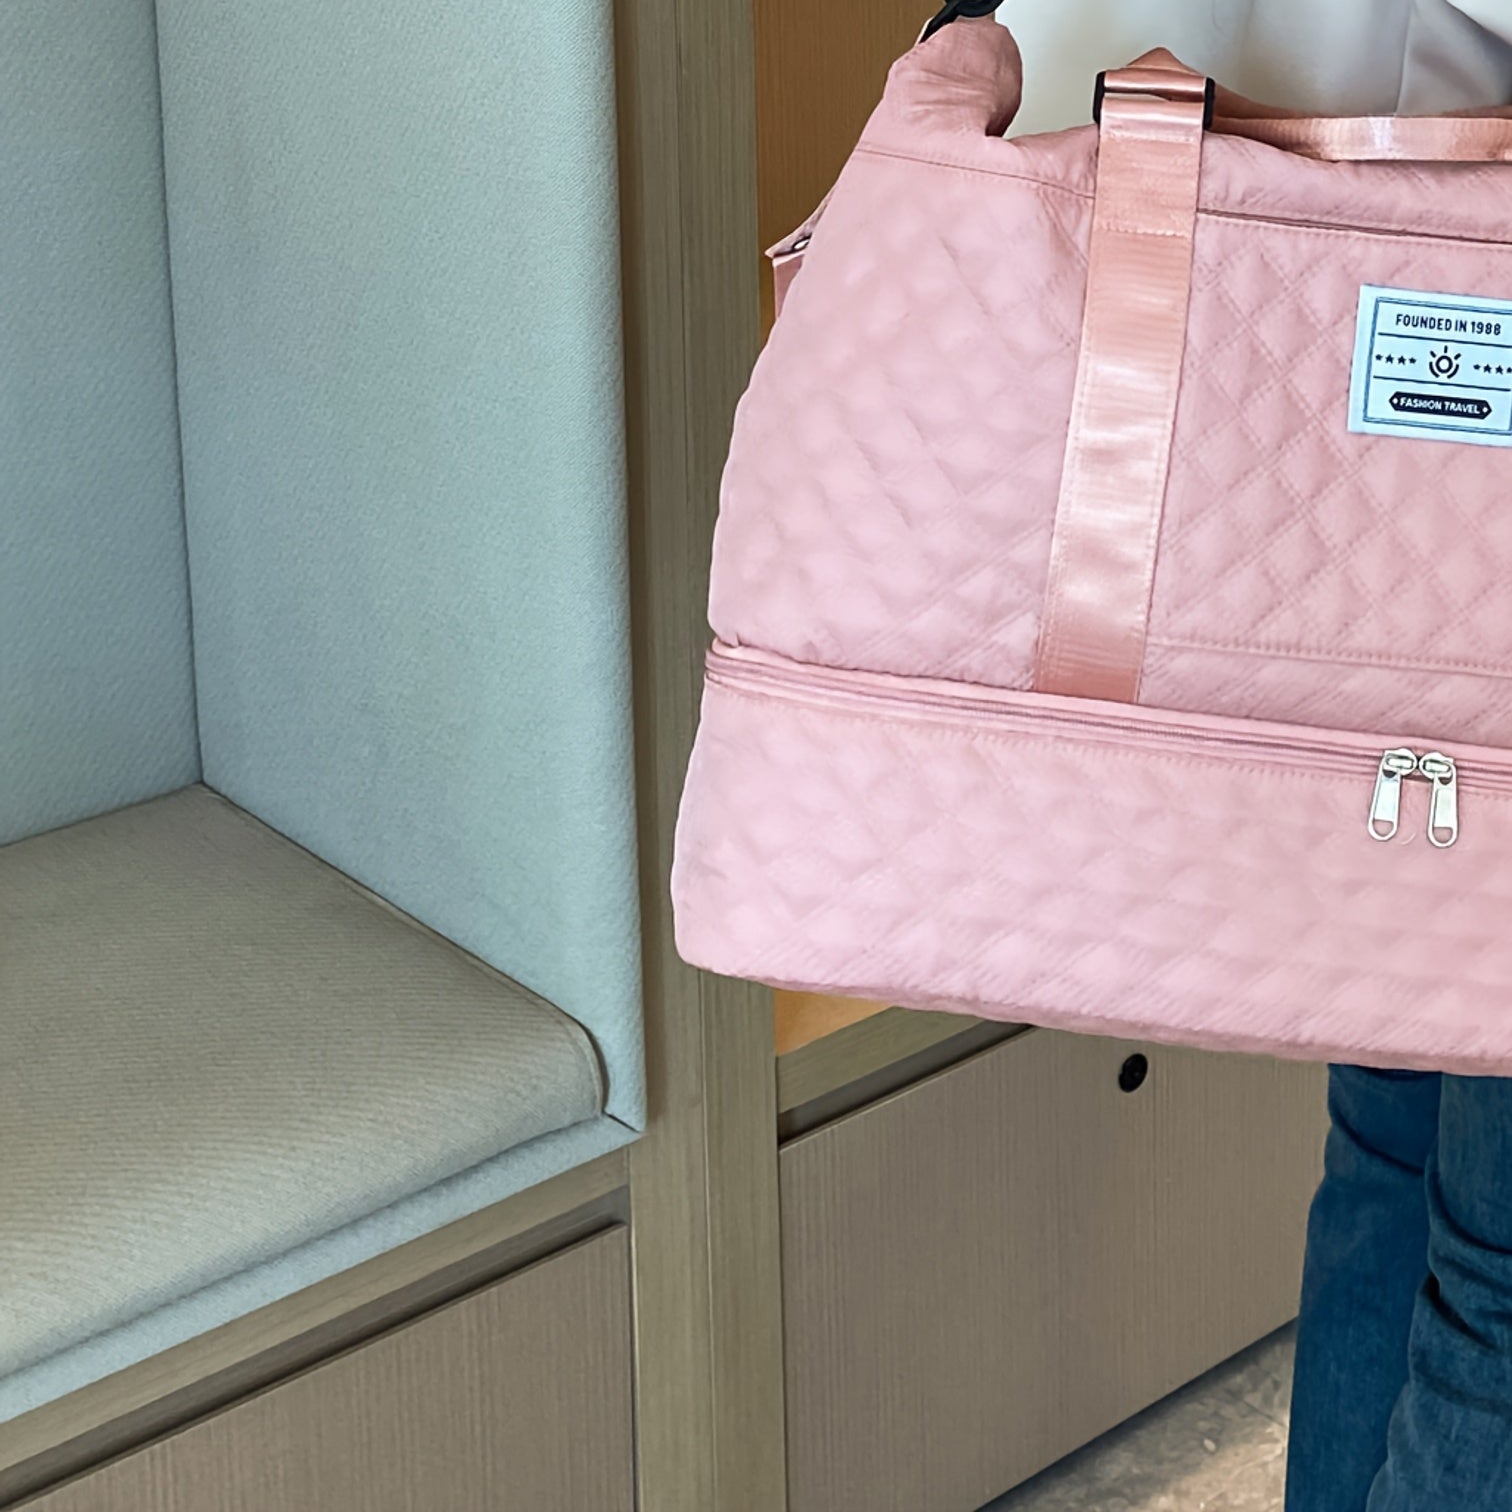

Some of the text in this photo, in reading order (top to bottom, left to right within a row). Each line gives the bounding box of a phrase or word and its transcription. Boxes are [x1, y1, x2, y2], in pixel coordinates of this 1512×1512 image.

[1395, 313, 1501, 336] FOUNDED IN 1988
[1400, 396, 1481, 414] FASHION TRAVEL
